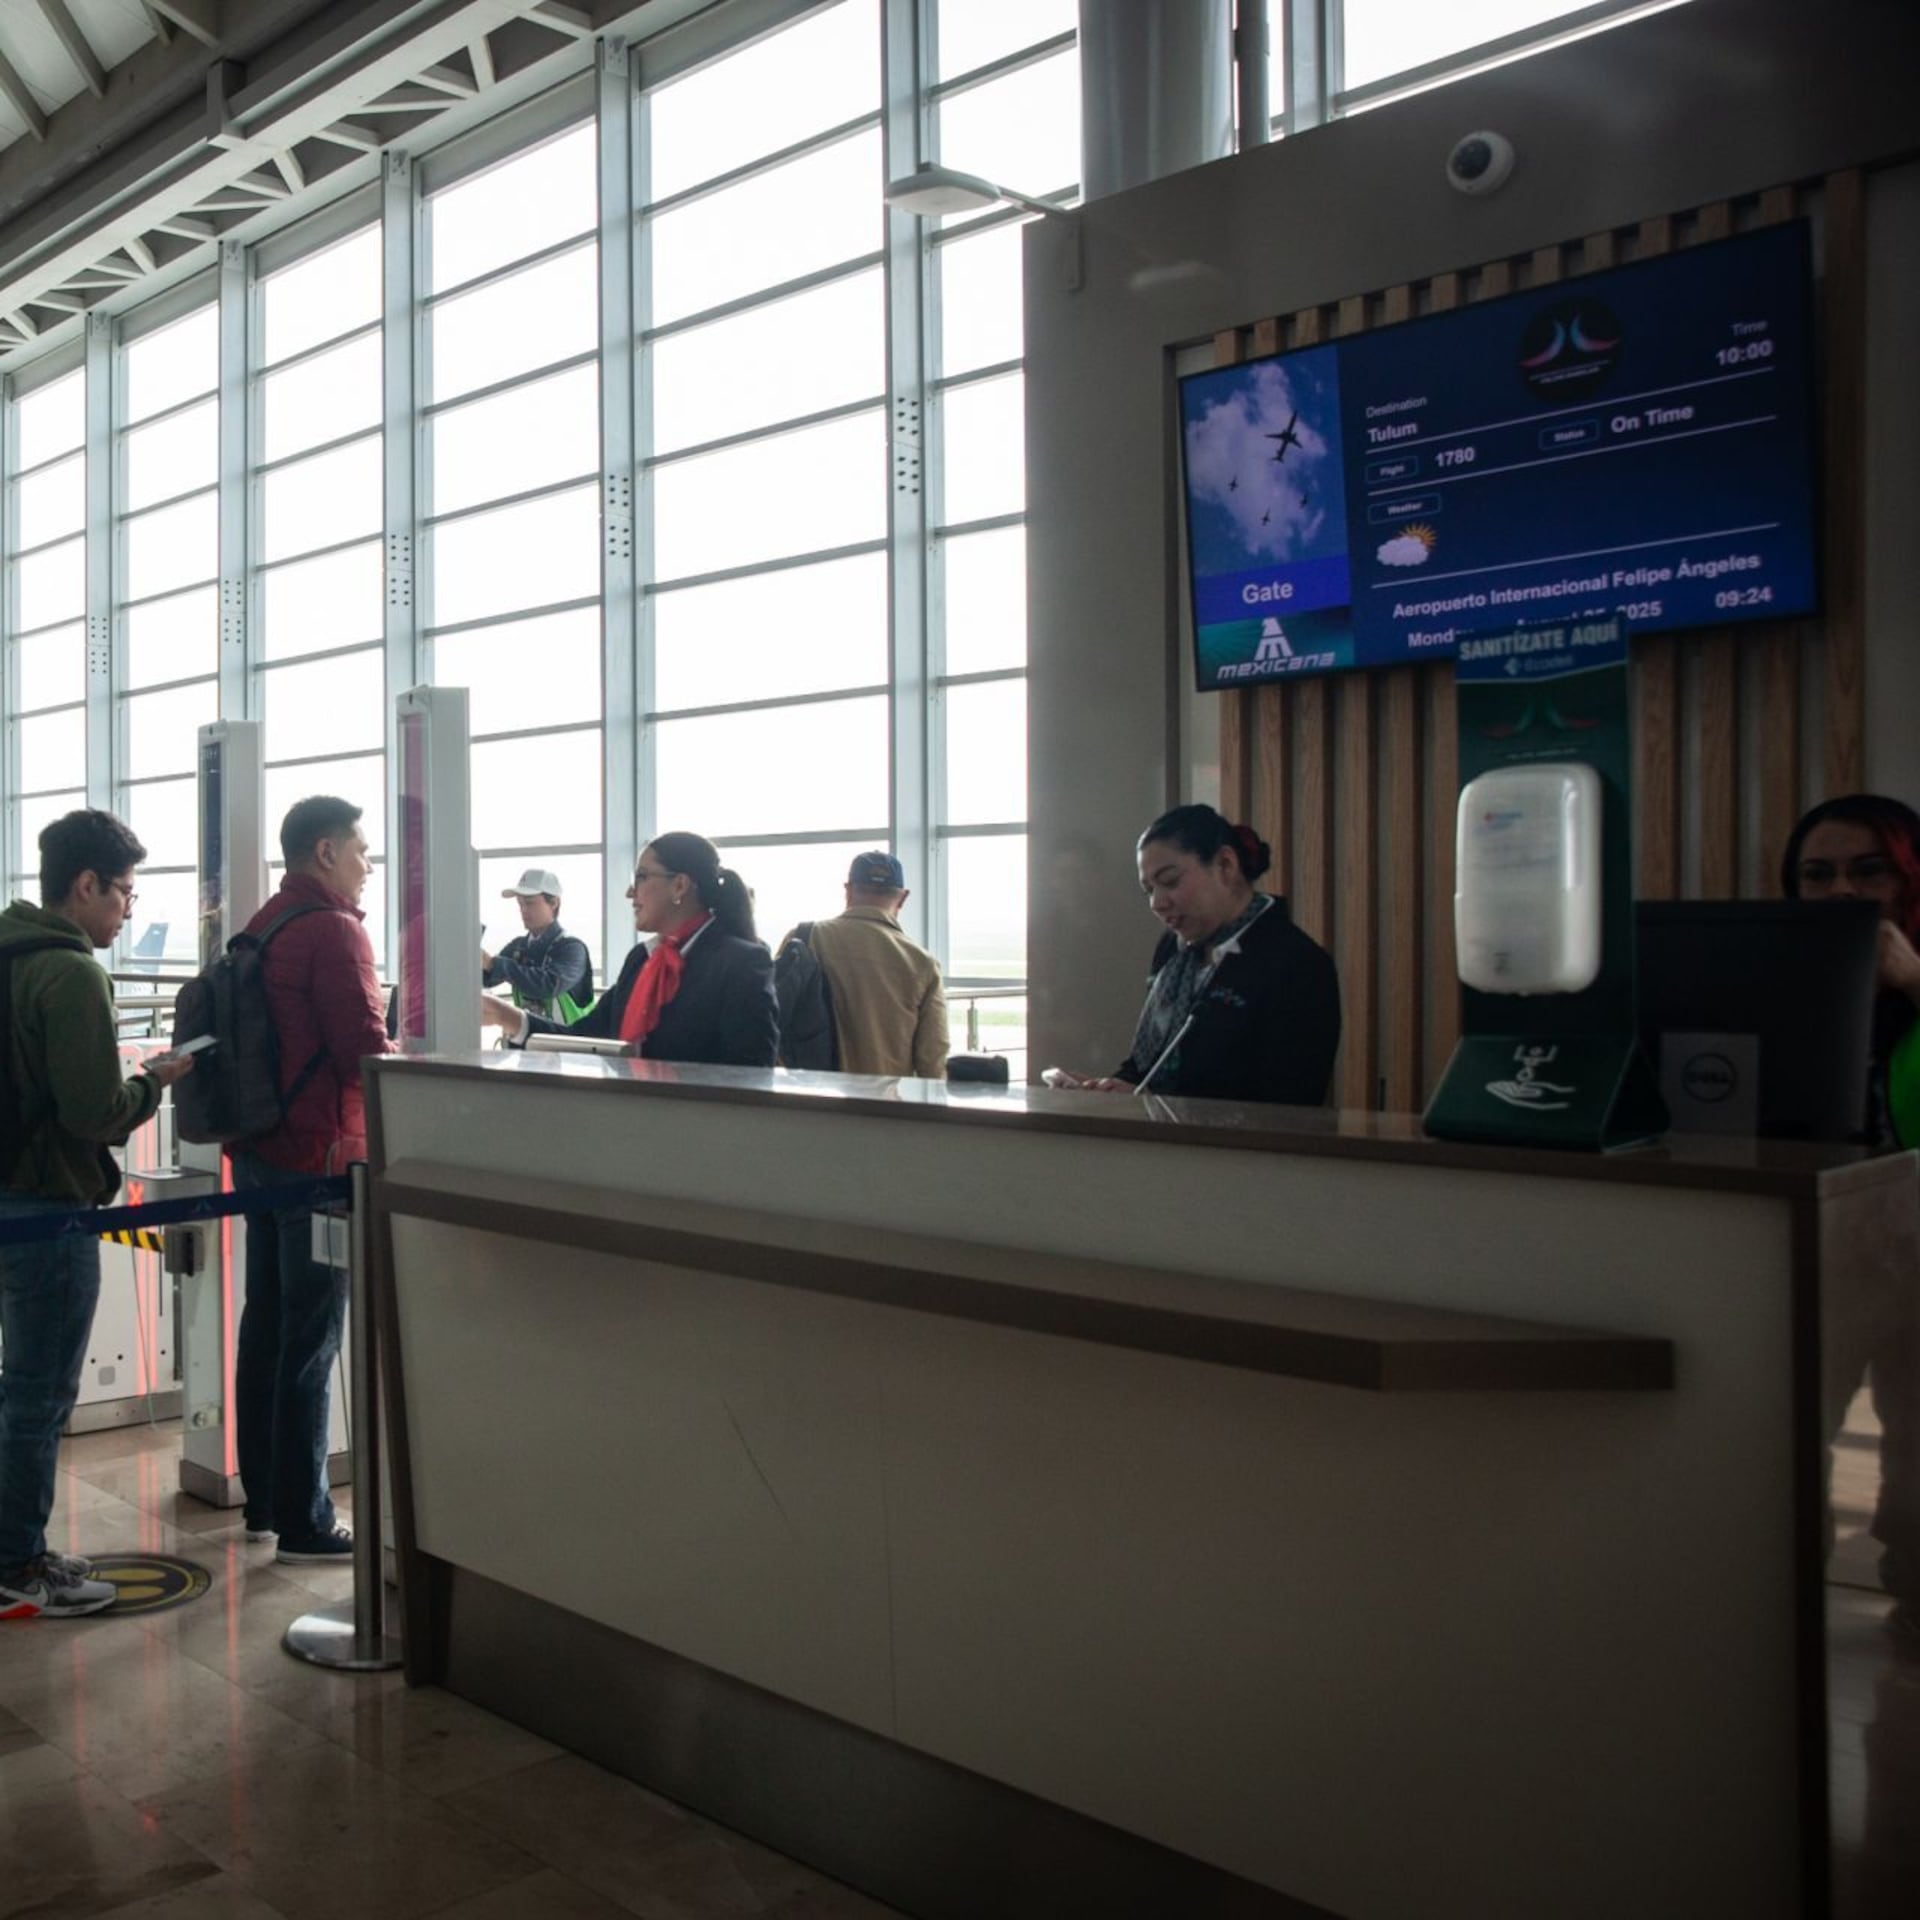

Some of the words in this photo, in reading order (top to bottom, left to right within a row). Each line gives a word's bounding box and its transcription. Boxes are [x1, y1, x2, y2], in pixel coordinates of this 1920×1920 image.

[1731, 320, 1768, 336] Time
[1715, 339, 1775, 367] 10:00
[1365, 396, 1428, 419] Destination
[1610, 415, 1641, 434] On
[1644, 405, 1695, 427] Time
[1367, 421, 1419, 444] Tulum
[1435, 446, 1476, 468] 1780
[1242, 581, 1294, 605] Gate
[1392, 592, 1487, 620] Aeropuerto
[1489, 575, 1609, 605] Internacional
[1612, 566, 1673, 588] Felipe
[1675, 553, 1763, 580] Ángeles
[1714, 585, 1775, 609] 09:24
[1408, 627, 1475, 648] Mond
[1458, 625, 1566, 661] SANITÍZATE
[1569, 615, 1621, 647] AQUÍ
[1216, 652, 1337, 681] mexicana
